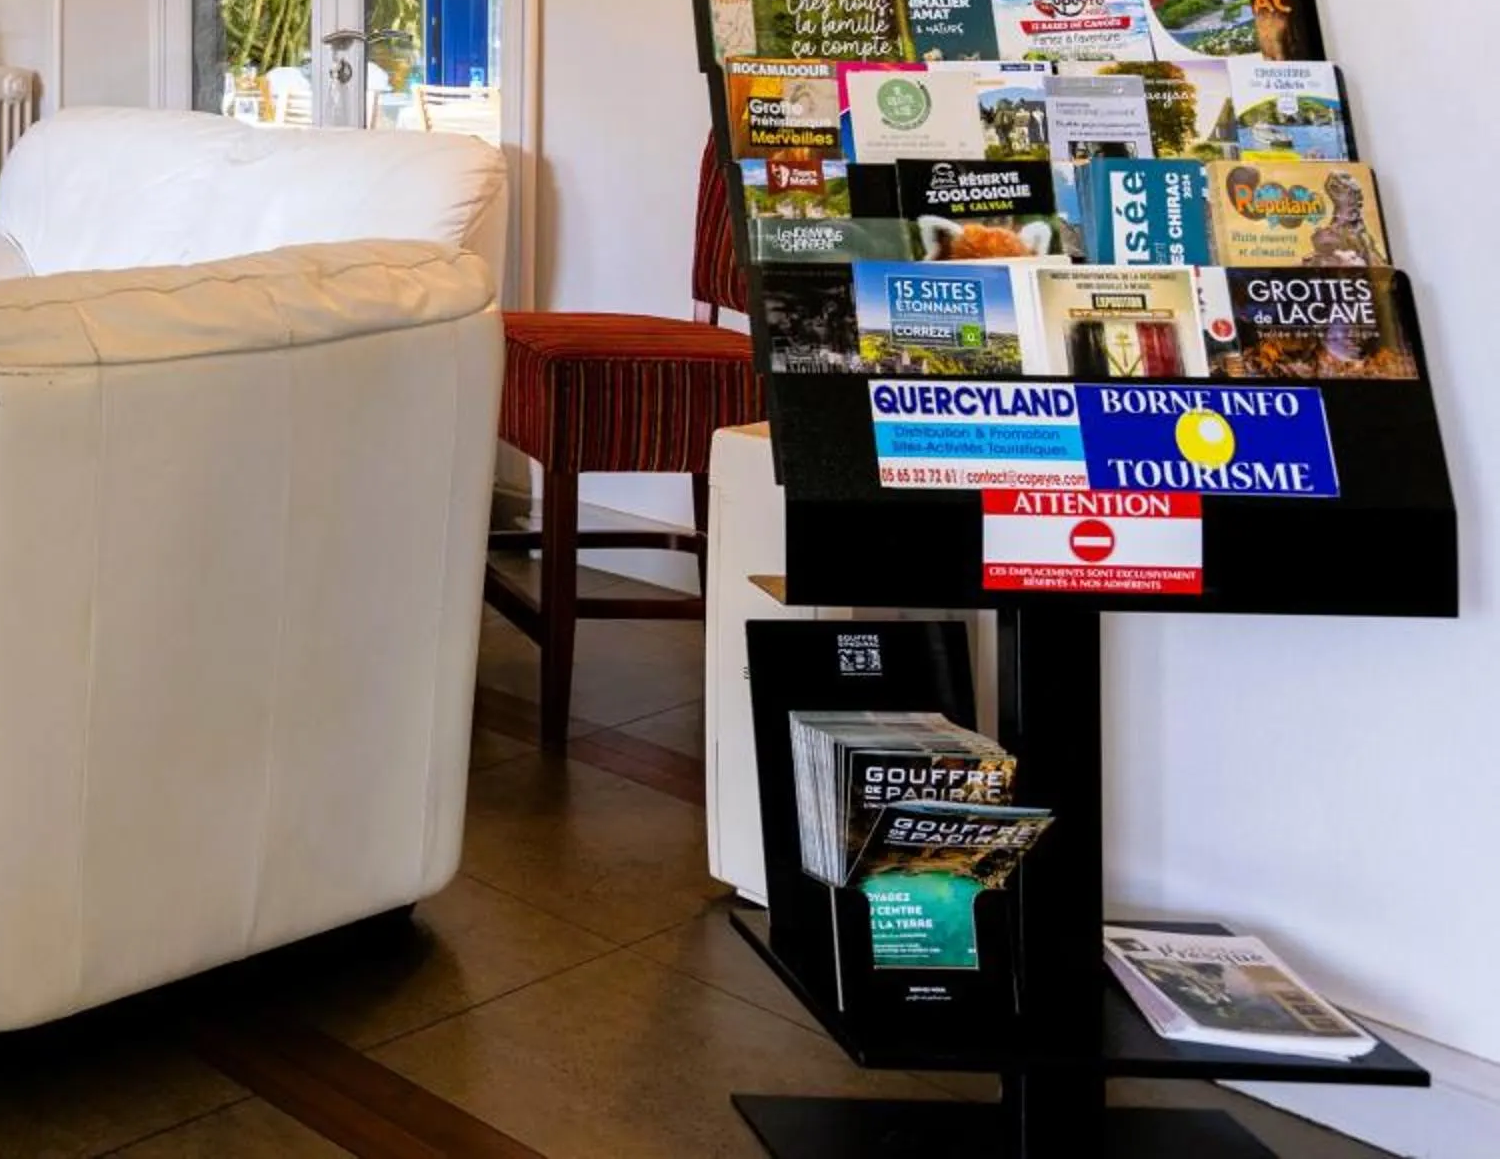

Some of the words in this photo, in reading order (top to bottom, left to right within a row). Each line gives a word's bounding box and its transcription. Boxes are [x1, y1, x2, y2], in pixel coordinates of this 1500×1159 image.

[910, 8, 950, 21] AMAT
[795, 15, 816, 34] la
[821, 12, 890, 38] famille
[791, 41, 817, 60] ça
[821, 35, 892, 63] compte
[731, 62, 830, 76] ROCAMADOUR
[749, 99, 803, 115] Grotte
[751, 129, 835, 146] Merveilles
[958, 171, 1020, 187] RÉSERVE
[925, 184, 1031, 204] ZOOLOGIQUE
[1164, 171, 1184, 239] CHIRAC
[894, 280, 914, 298] 15
[921, 280, 977, 300] SITES
[1247, 278, 1372, 303] GROTTES
[1253, 310, 1273, 325] de
[1276, 301, 1377, 325] LACAVE
[873, 384, 1076, 418] QUERCYLAND
[1100, 388, 1211, 415] BORNE
[1220, 390, 1300, 418] INFO
[893, 426, 970, 440] Distribution
[974, 427, 986, 440] &
[989, 427, 1061, 441] Promotion
[986, 442, 1068, 458] Touristiques
[881, 468, 895, 483] 05
[897, 468, 911, 483] 65
[913, 469, 926, 483] 32
[1107, 458, 1315, 492] TOURISME
[1013, 491, 1171, 516] ATTENTION
[989, 567, 1007, 576] CES
[1009, 567, 1085, 578] EMPLACEMENTS
[1086, 569, 1114, 579] SONT
[1117, 569, 1197, 581] EXCLUSIVEMENT
[865, 766, 1004, 786] GOUFFRE
[886, 786, 1002, 804] PADIRAC
[893, 817, 1038, 836] GOUFFRE
[909, 832, 1031, 846] PADIRAC
[867, 892, 911, 903] OYAGEZ
[877, 905, 923, 916] CENTRE
[878, 920, 893, 930] LA
[895, 918, 933, 929] TERRE
